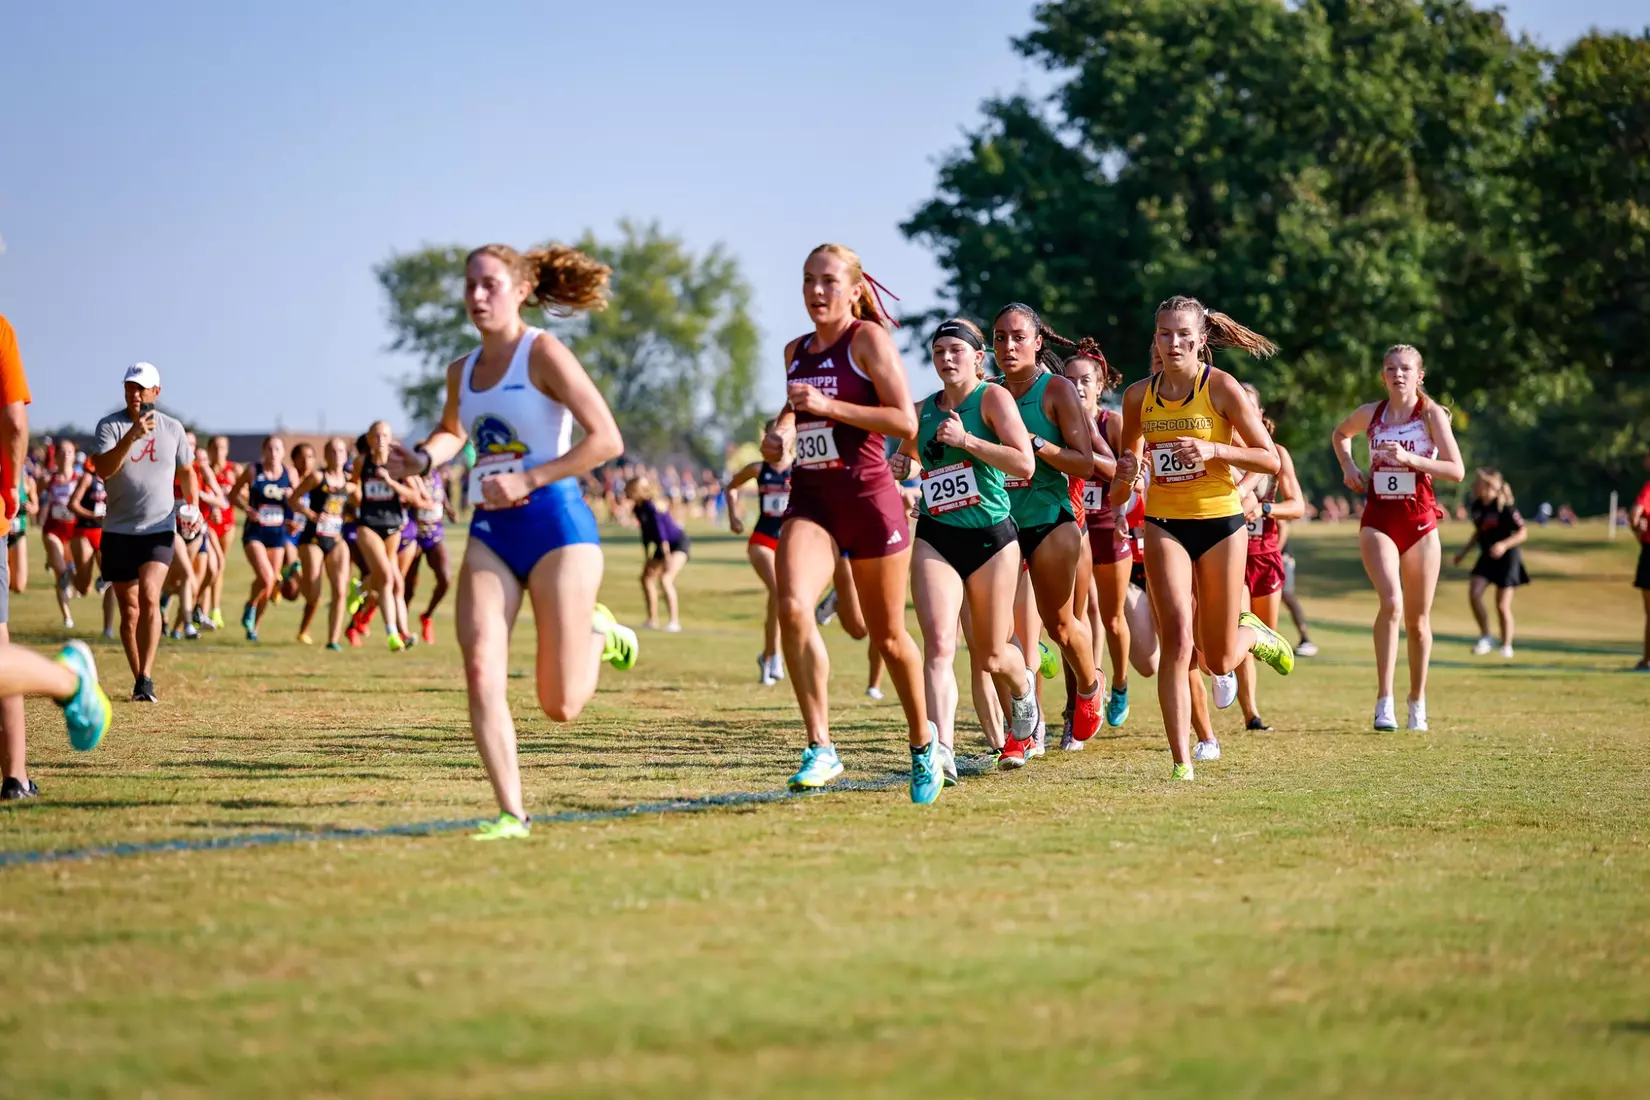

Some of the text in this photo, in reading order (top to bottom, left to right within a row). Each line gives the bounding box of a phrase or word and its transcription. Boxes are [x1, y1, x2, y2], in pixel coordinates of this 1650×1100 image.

[131, 437, 158, 463] A
[930, 474, 970, 502] 295
[1387, 476, 1398, 491] 8
